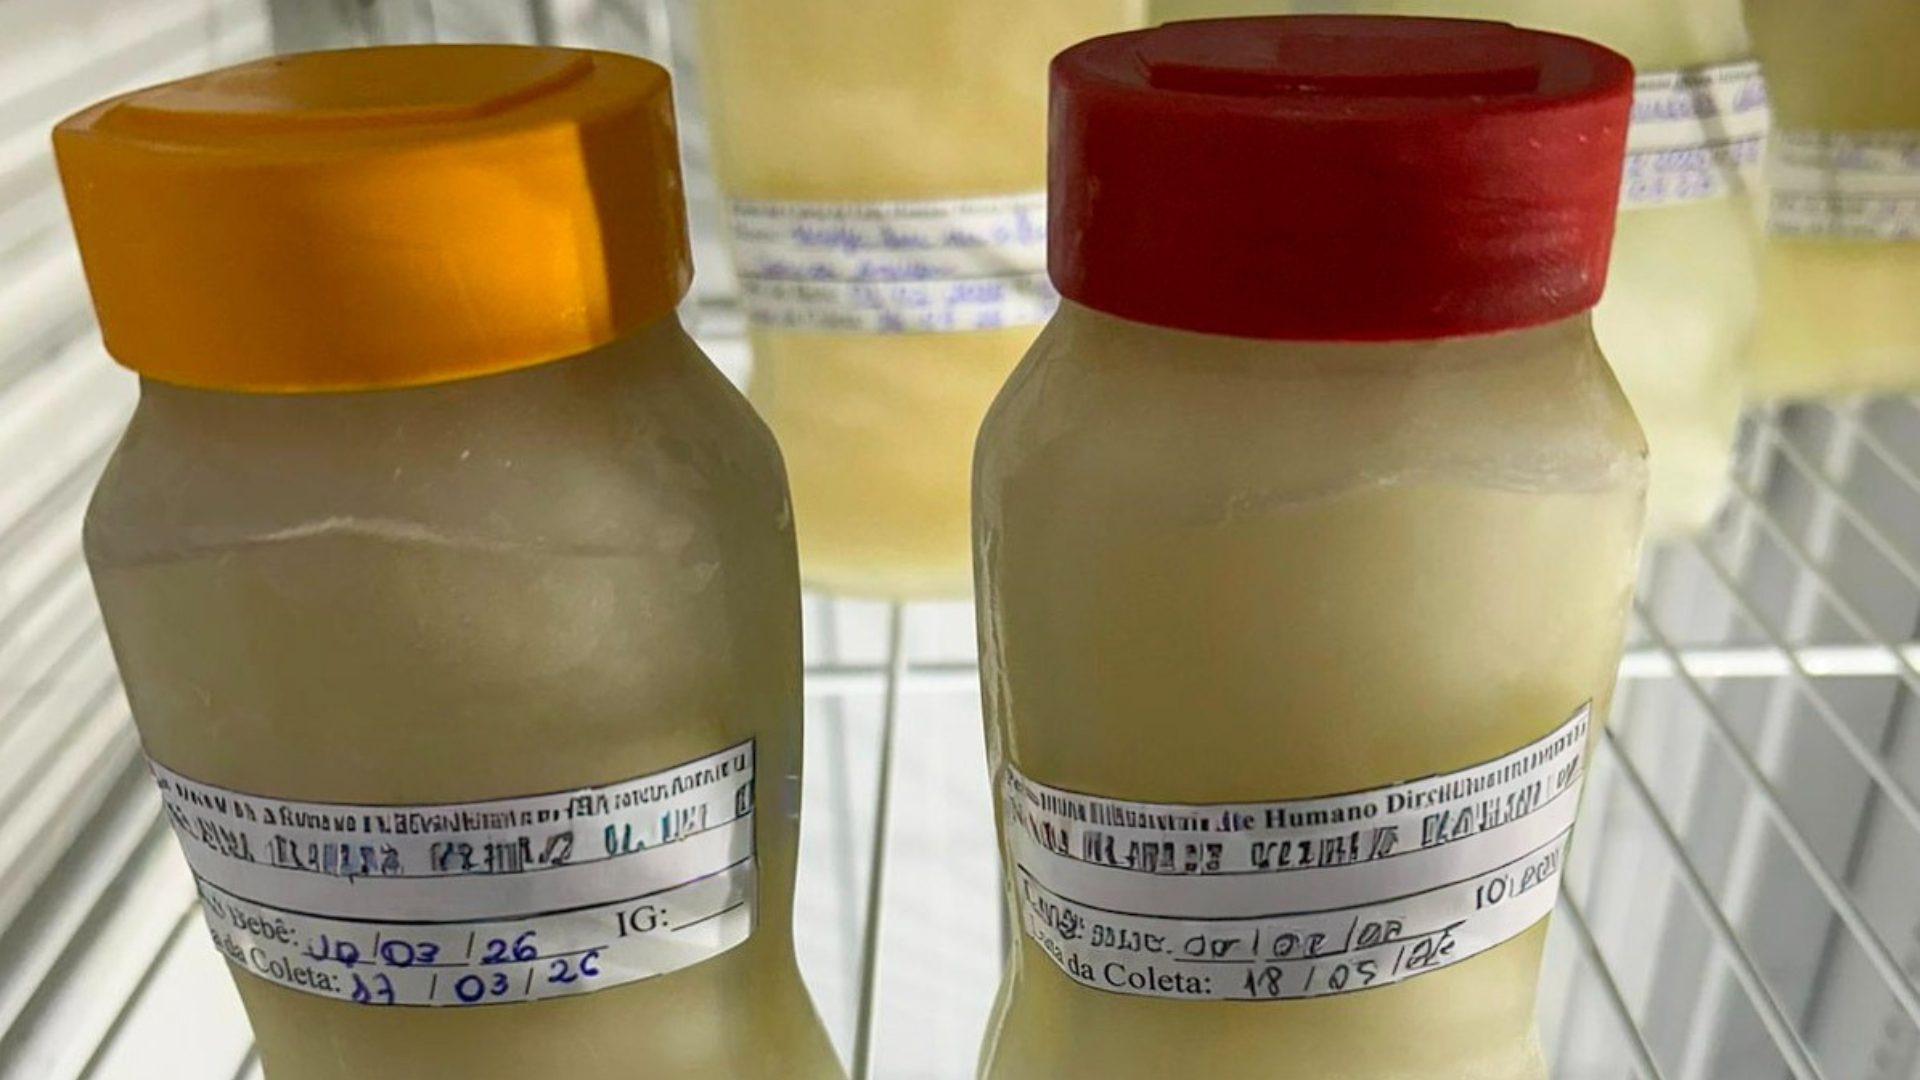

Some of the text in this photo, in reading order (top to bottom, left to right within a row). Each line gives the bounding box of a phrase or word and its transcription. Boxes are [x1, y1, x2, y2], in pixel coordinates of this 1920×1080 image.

[1265, 802, 1378, 829] Humano
[616, 904, 669, 938] IG:
[250, 947, 341, 993] Coleta:
[1068, 953, 1213, 995] da Coleta:
